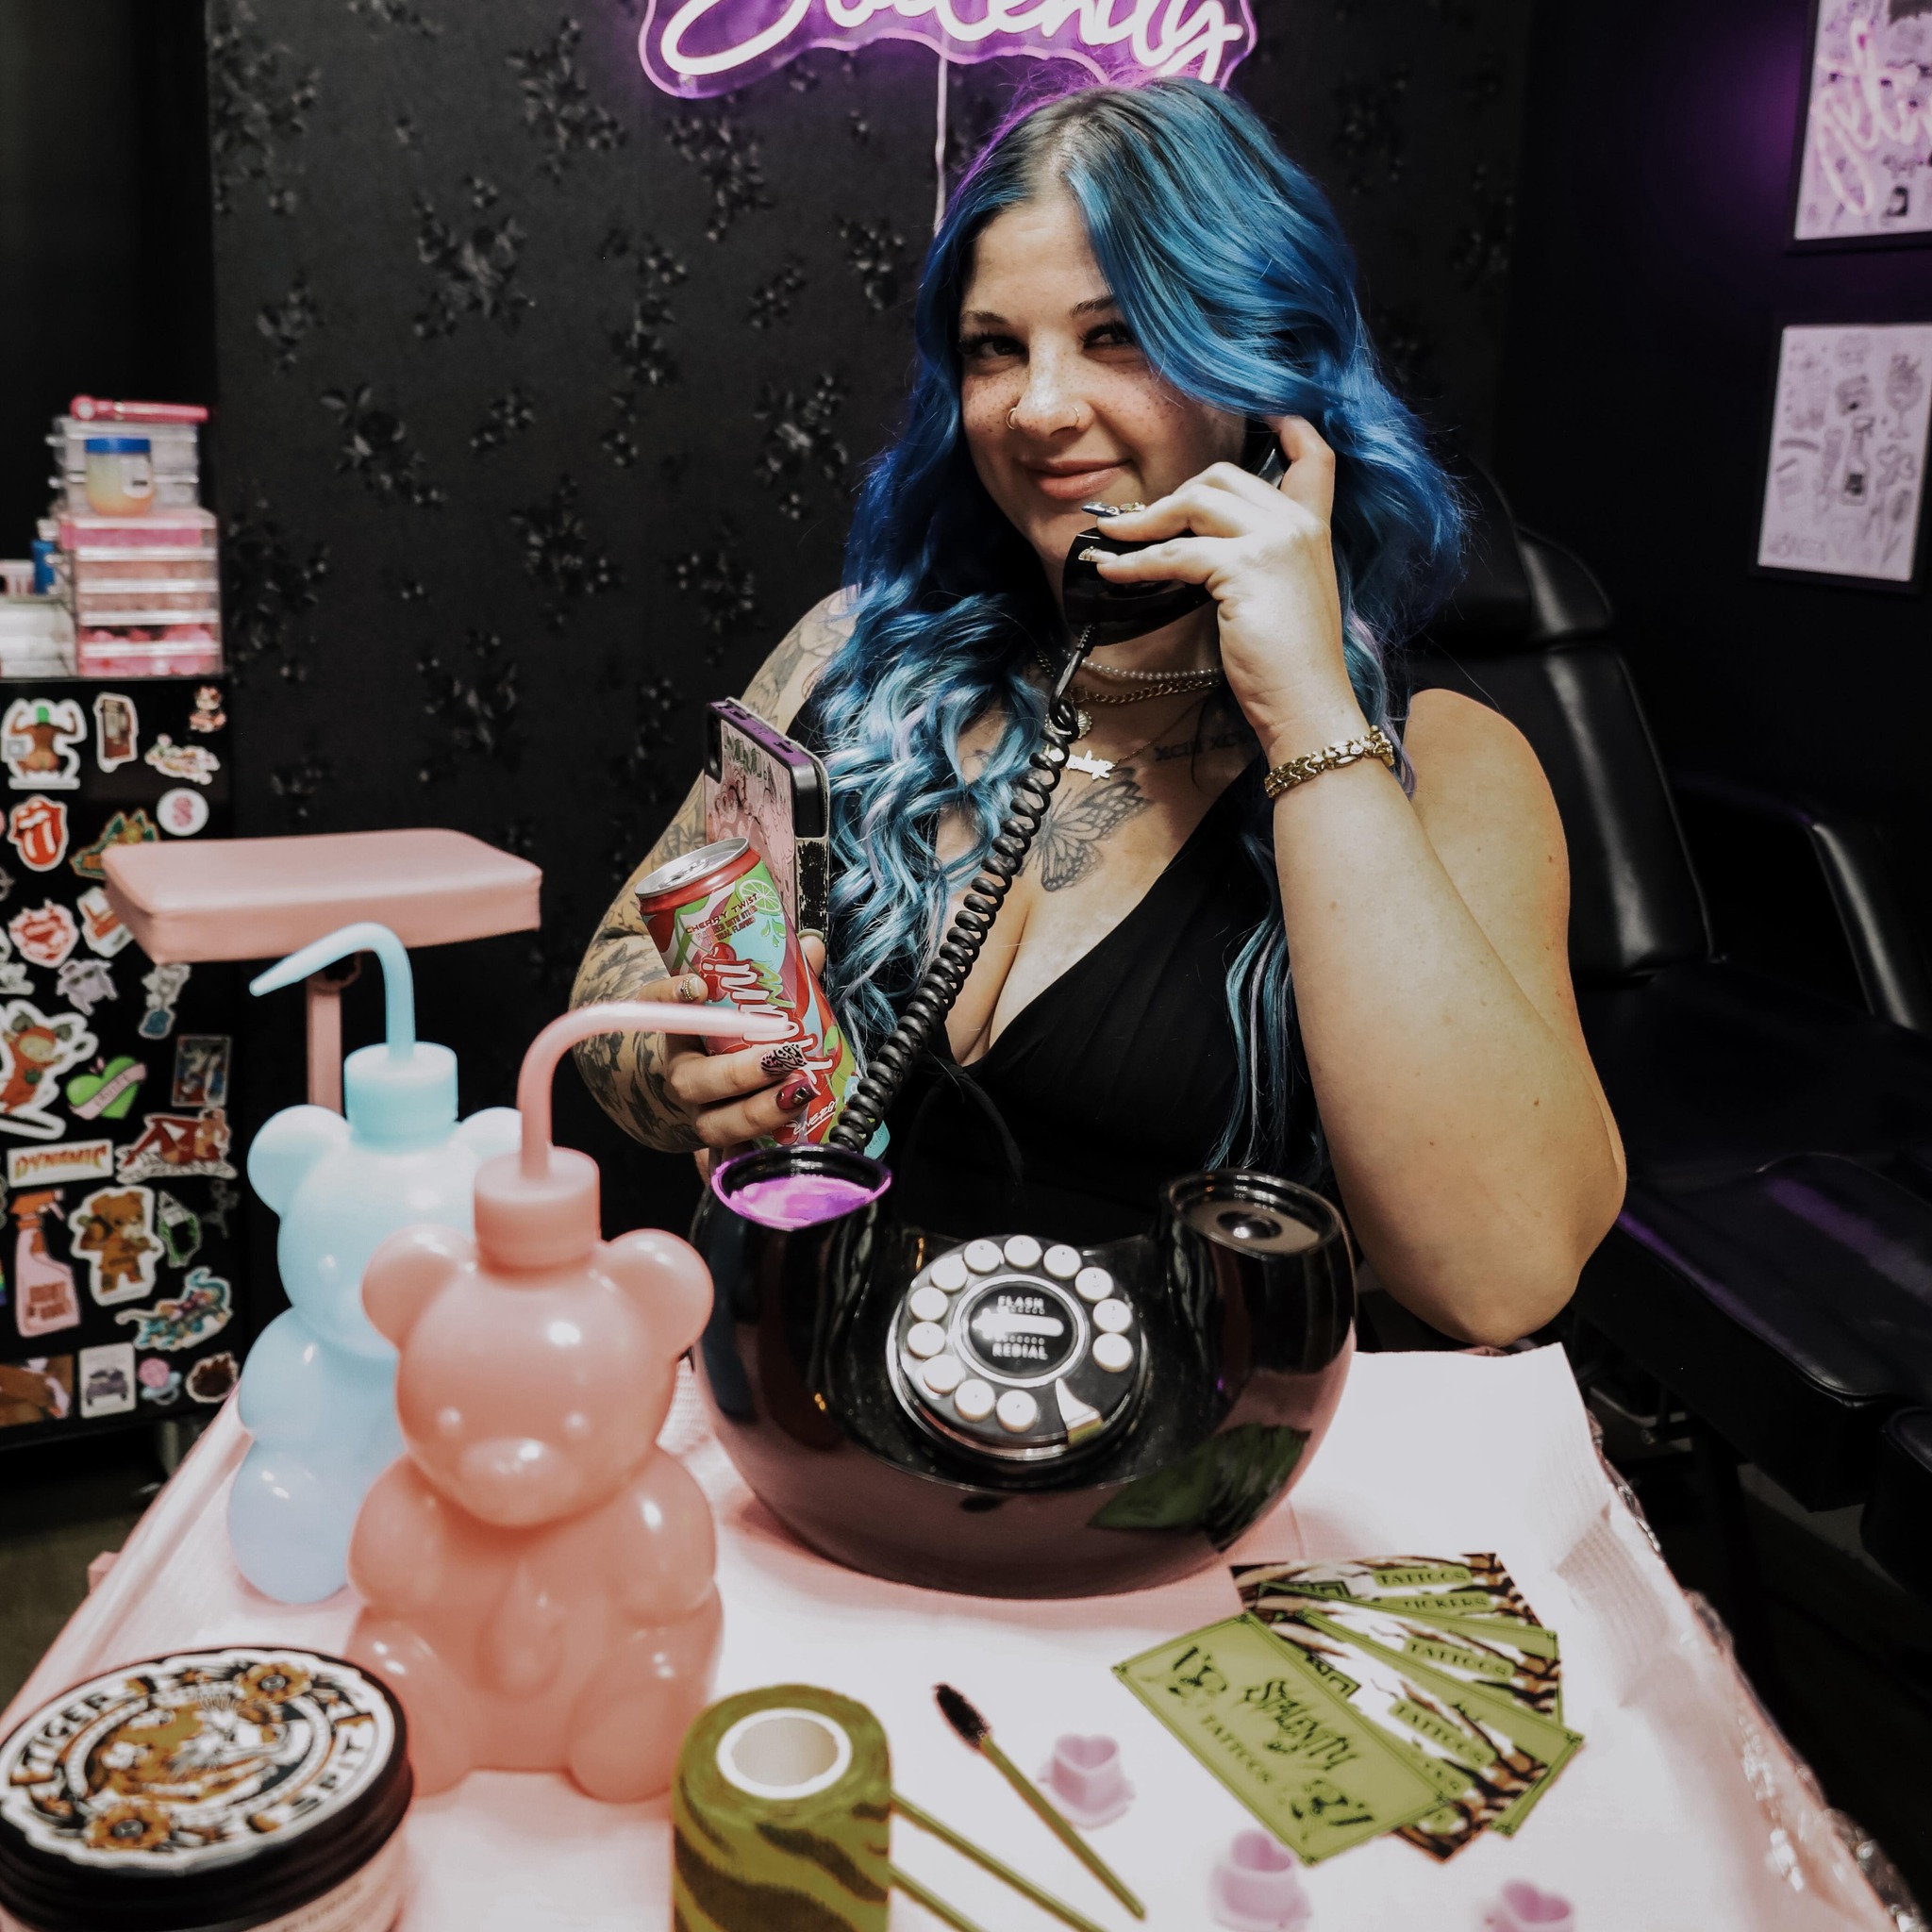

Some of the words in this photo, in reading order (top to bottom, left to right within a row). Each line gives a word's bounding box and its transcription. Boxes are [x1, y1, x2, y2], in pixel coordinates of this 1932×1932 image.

[685, 910, 727, 934] CHERRY
[731, 893, 758, 912] TWIST
[998, 1295, 1044, 1309] FLASH
[992, 1342, 1048, 1359] REDIAL
[1379, 1571, 1467, 1585] TATTOOS
[1410, 1642, 1507, 1676] TATTOOS
